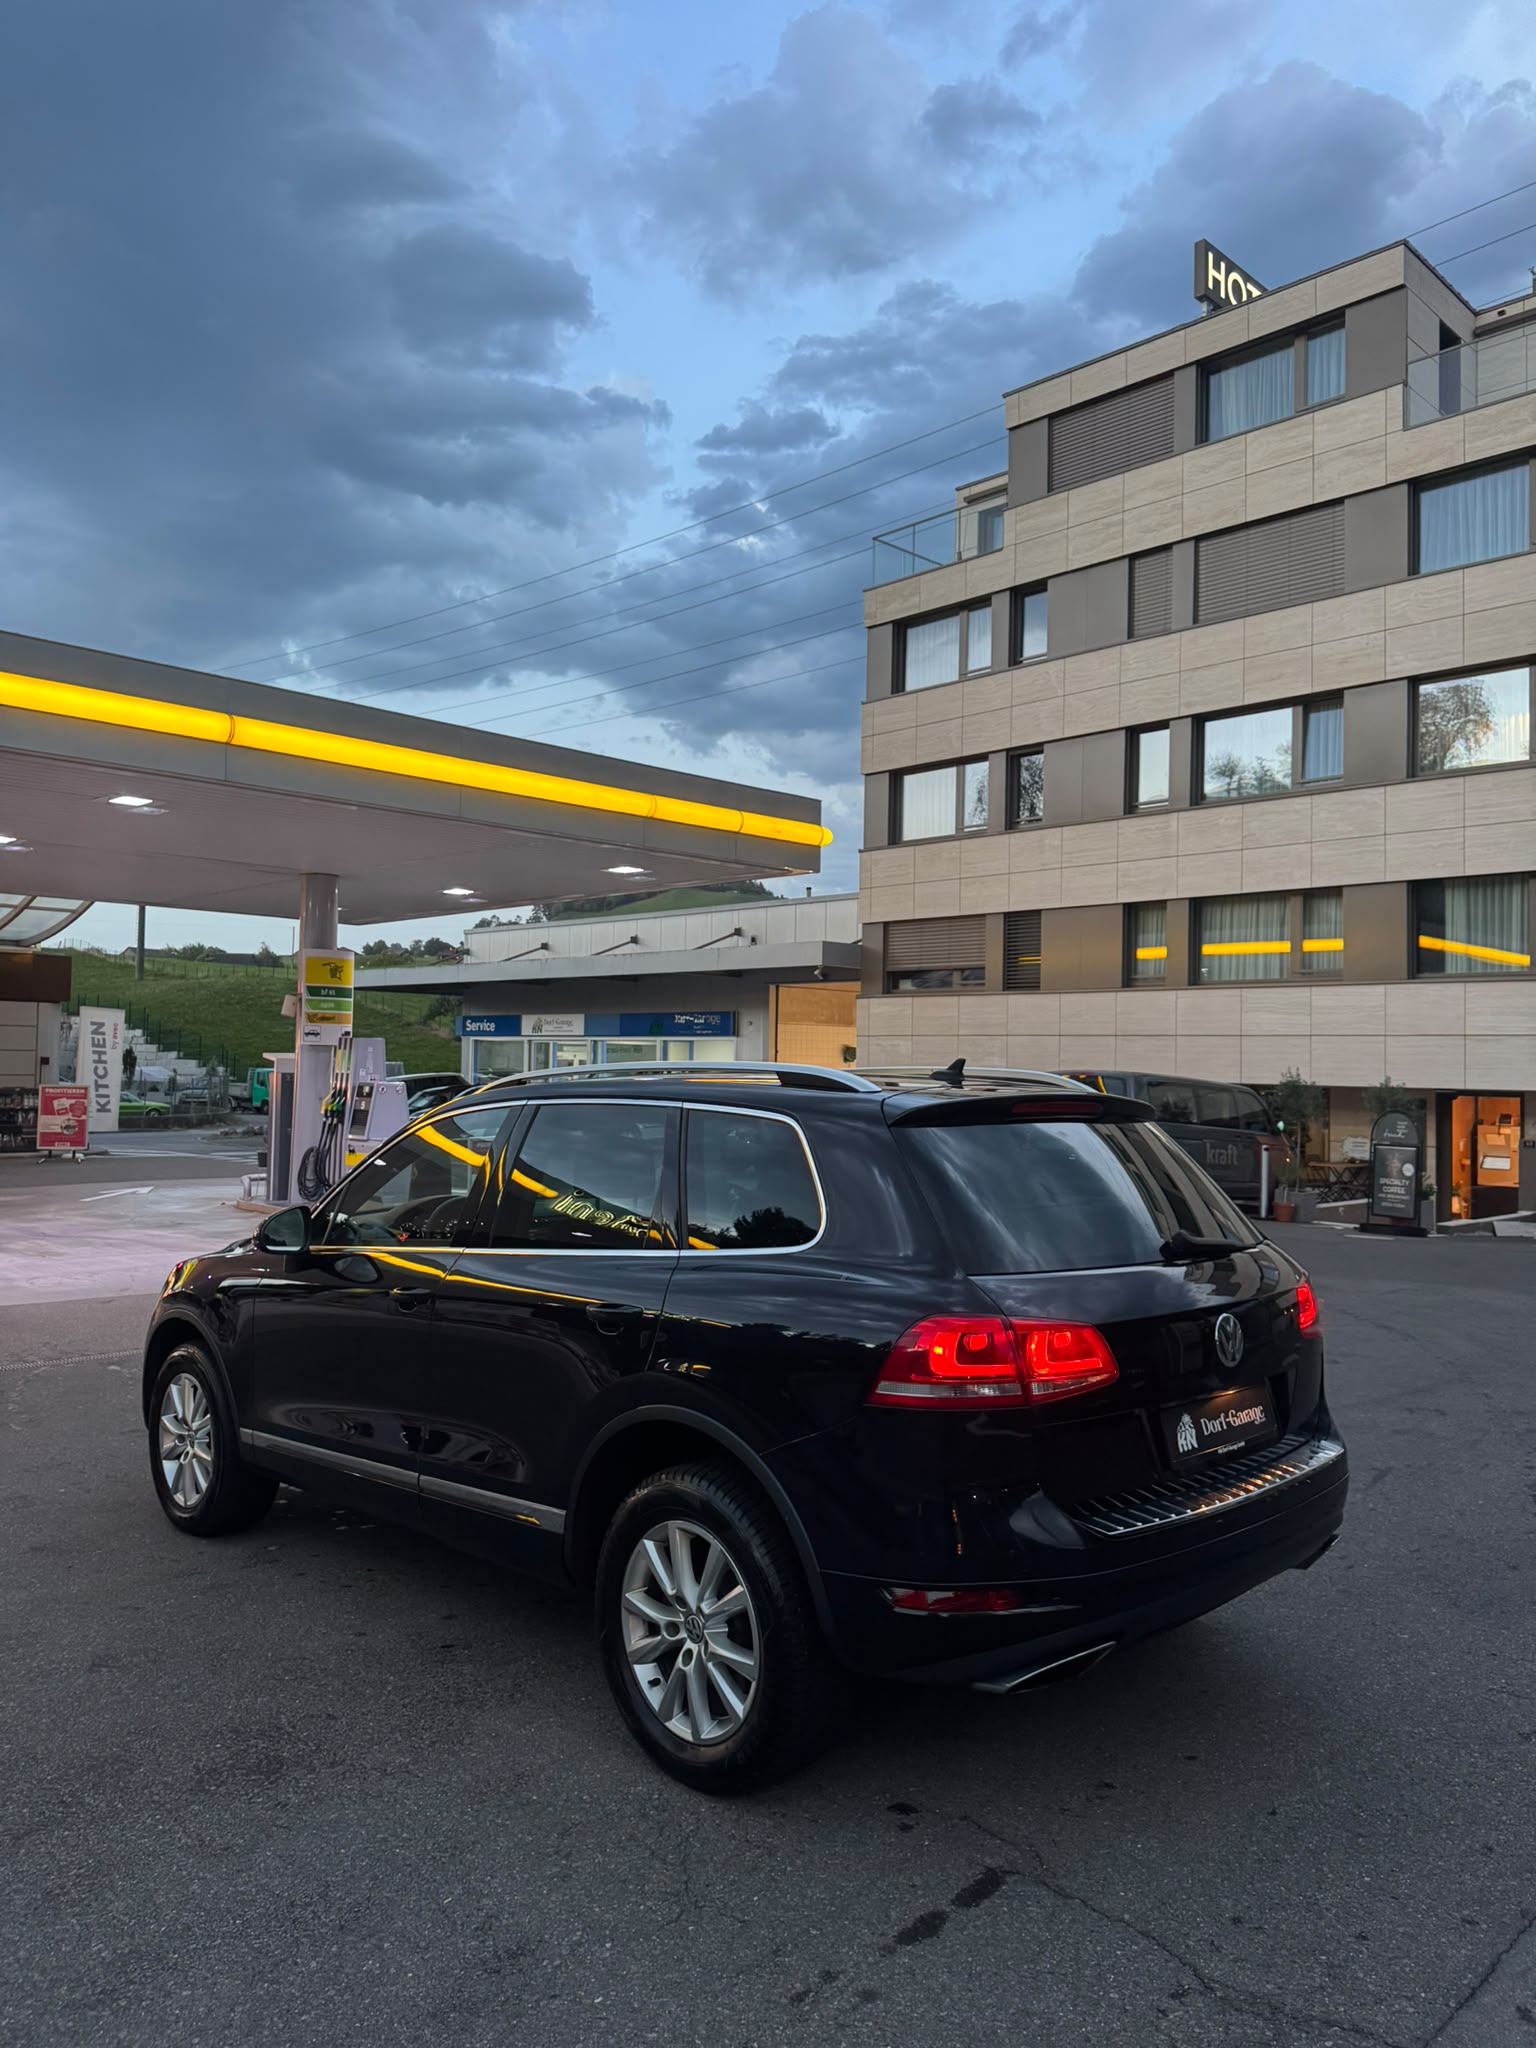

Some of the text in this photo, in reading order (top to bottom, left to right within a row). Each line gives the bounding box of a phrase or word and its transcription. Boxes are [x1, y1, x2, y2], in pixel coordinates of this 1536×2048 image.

[465, 1018, 496, 1032] Service
[110, 1040, 120, 1050] by
[90, 1020, 112, 1114] KITCHEN
[1205, 1142, 1239, 1166] kraft
[1382, 1186, 1407, 1195] COFFEE
[1200, 1405, 1266, 1436] Dorf-Garage
